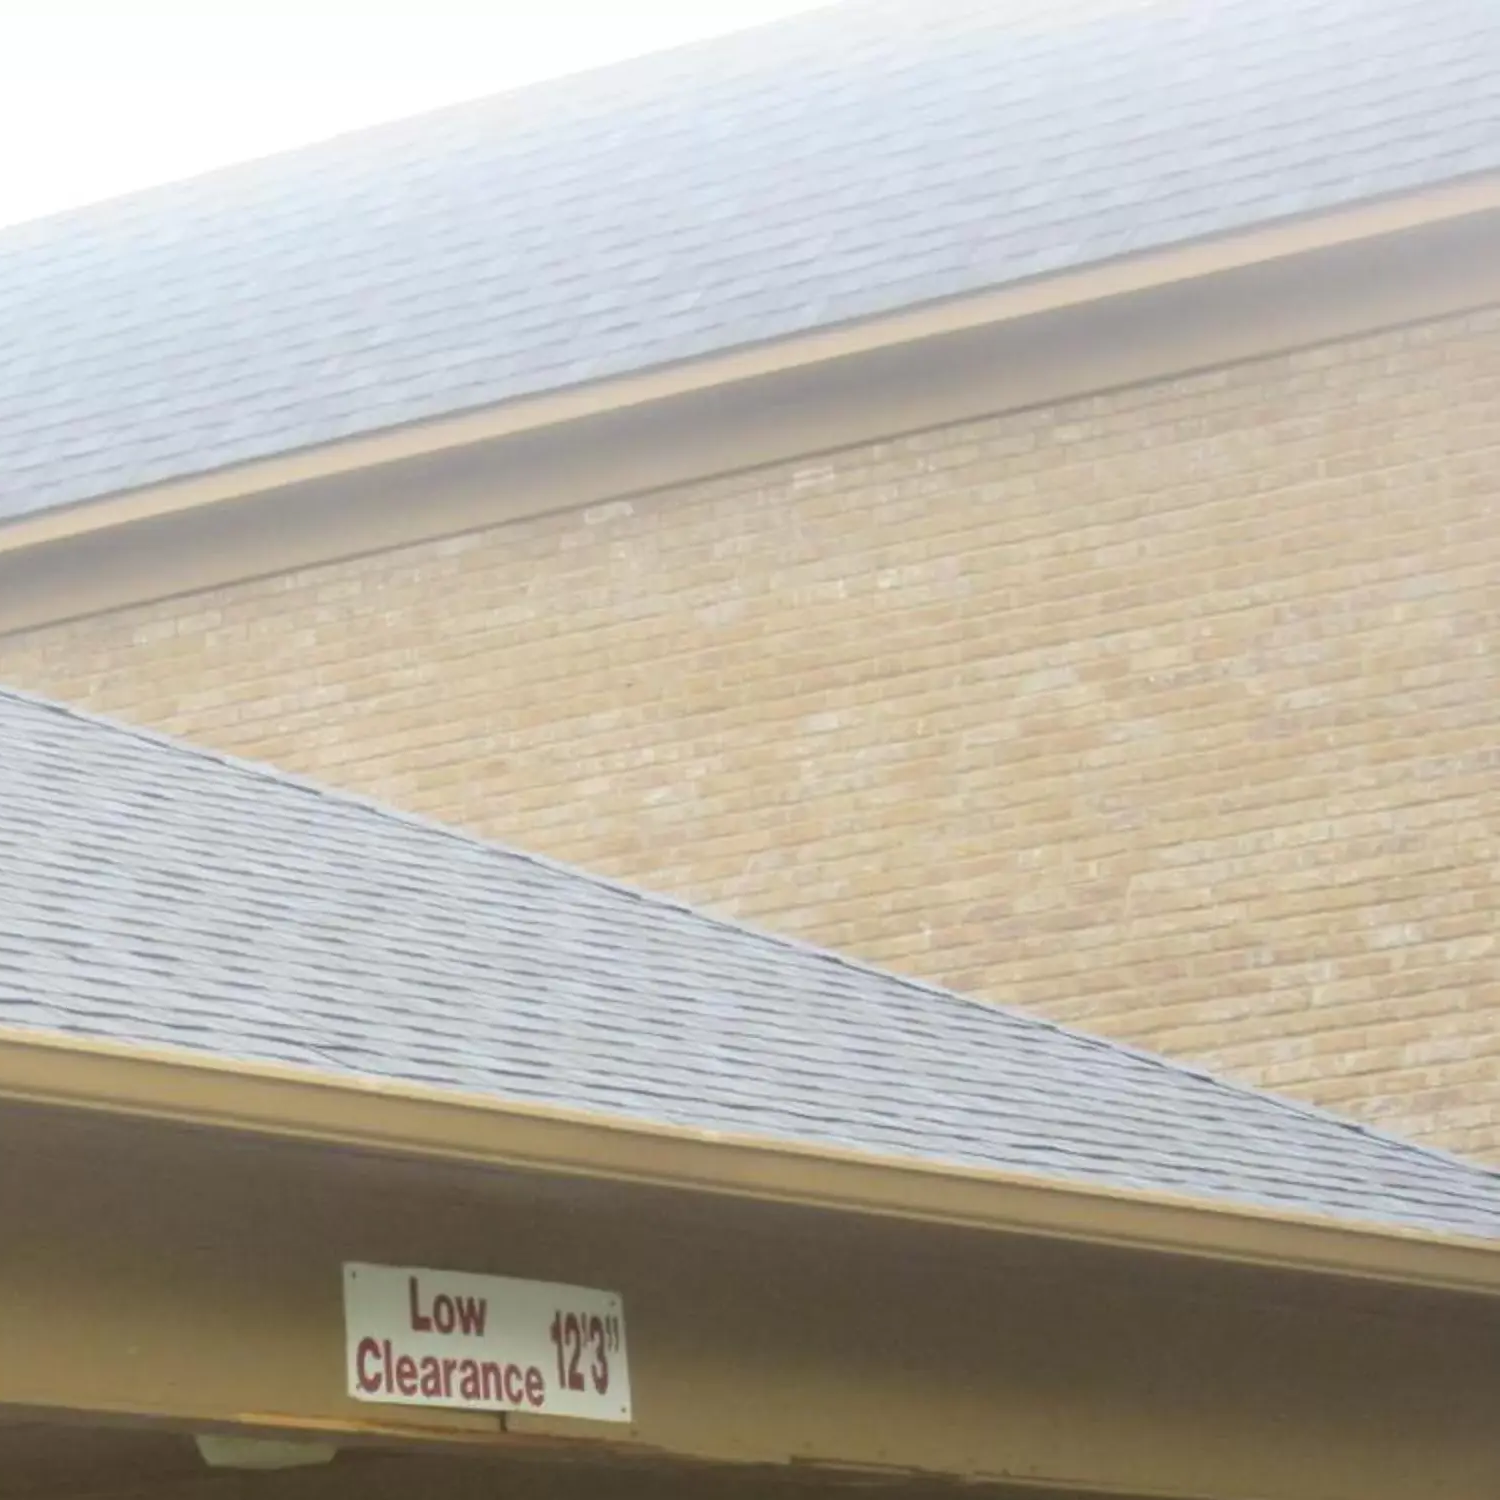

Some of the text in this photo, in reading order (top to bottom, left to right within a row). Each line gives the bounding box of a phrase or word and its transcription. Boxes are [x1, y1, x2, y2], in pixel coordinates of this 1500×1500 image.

[408, 1275, 487, 1337] Low
[356, 1336, 545, 1408] Clearance
[550, 1309, 619, 1396] 12'3"
